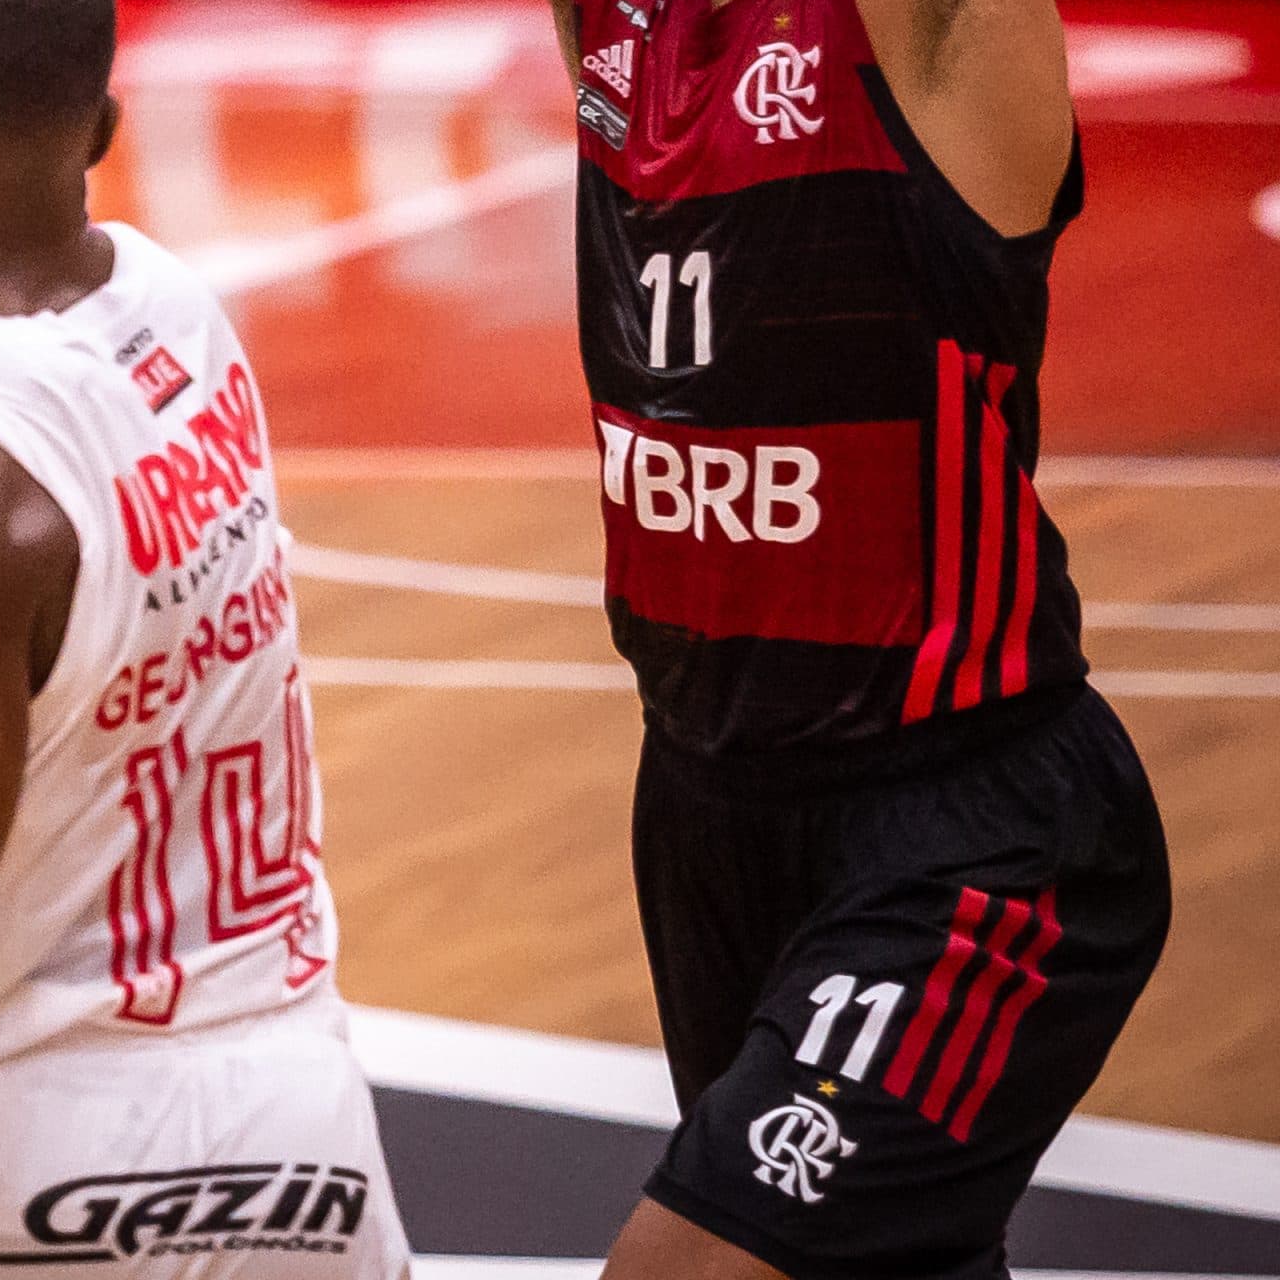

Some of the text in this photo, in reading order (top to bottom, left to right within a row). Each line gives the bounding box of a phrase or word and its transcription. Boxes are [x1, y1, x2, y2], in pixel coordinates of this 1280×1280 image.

[638, 250, 713, 369] 11
[632, 435, 821, 544] BRB
[794, 973, 905, 1082] 11
[24, 1163, 368, 1256] GAZIN
